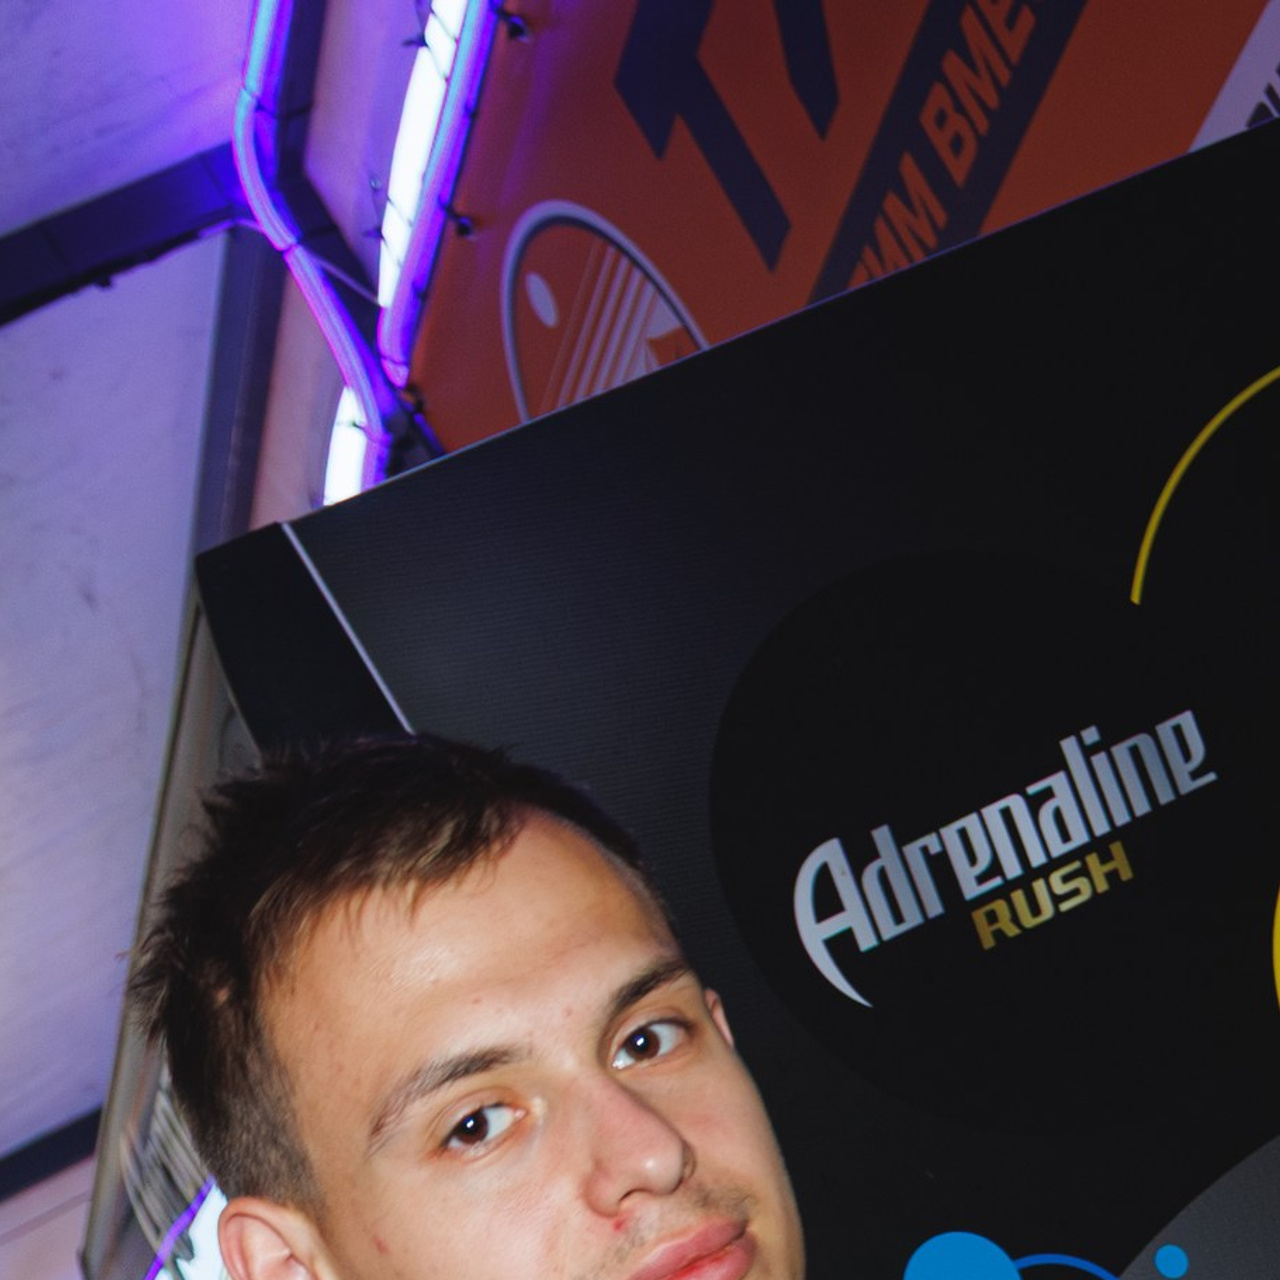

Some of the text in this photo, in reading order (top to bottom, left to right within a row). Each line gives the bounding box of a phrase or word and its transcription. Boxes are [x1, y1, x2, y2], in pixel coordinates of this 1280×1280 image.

[846, 150, 949, 292] ИМ
[793, 708, 1218, 1009] Adrenaline
[970, 840, 1135, 951] RUSH
